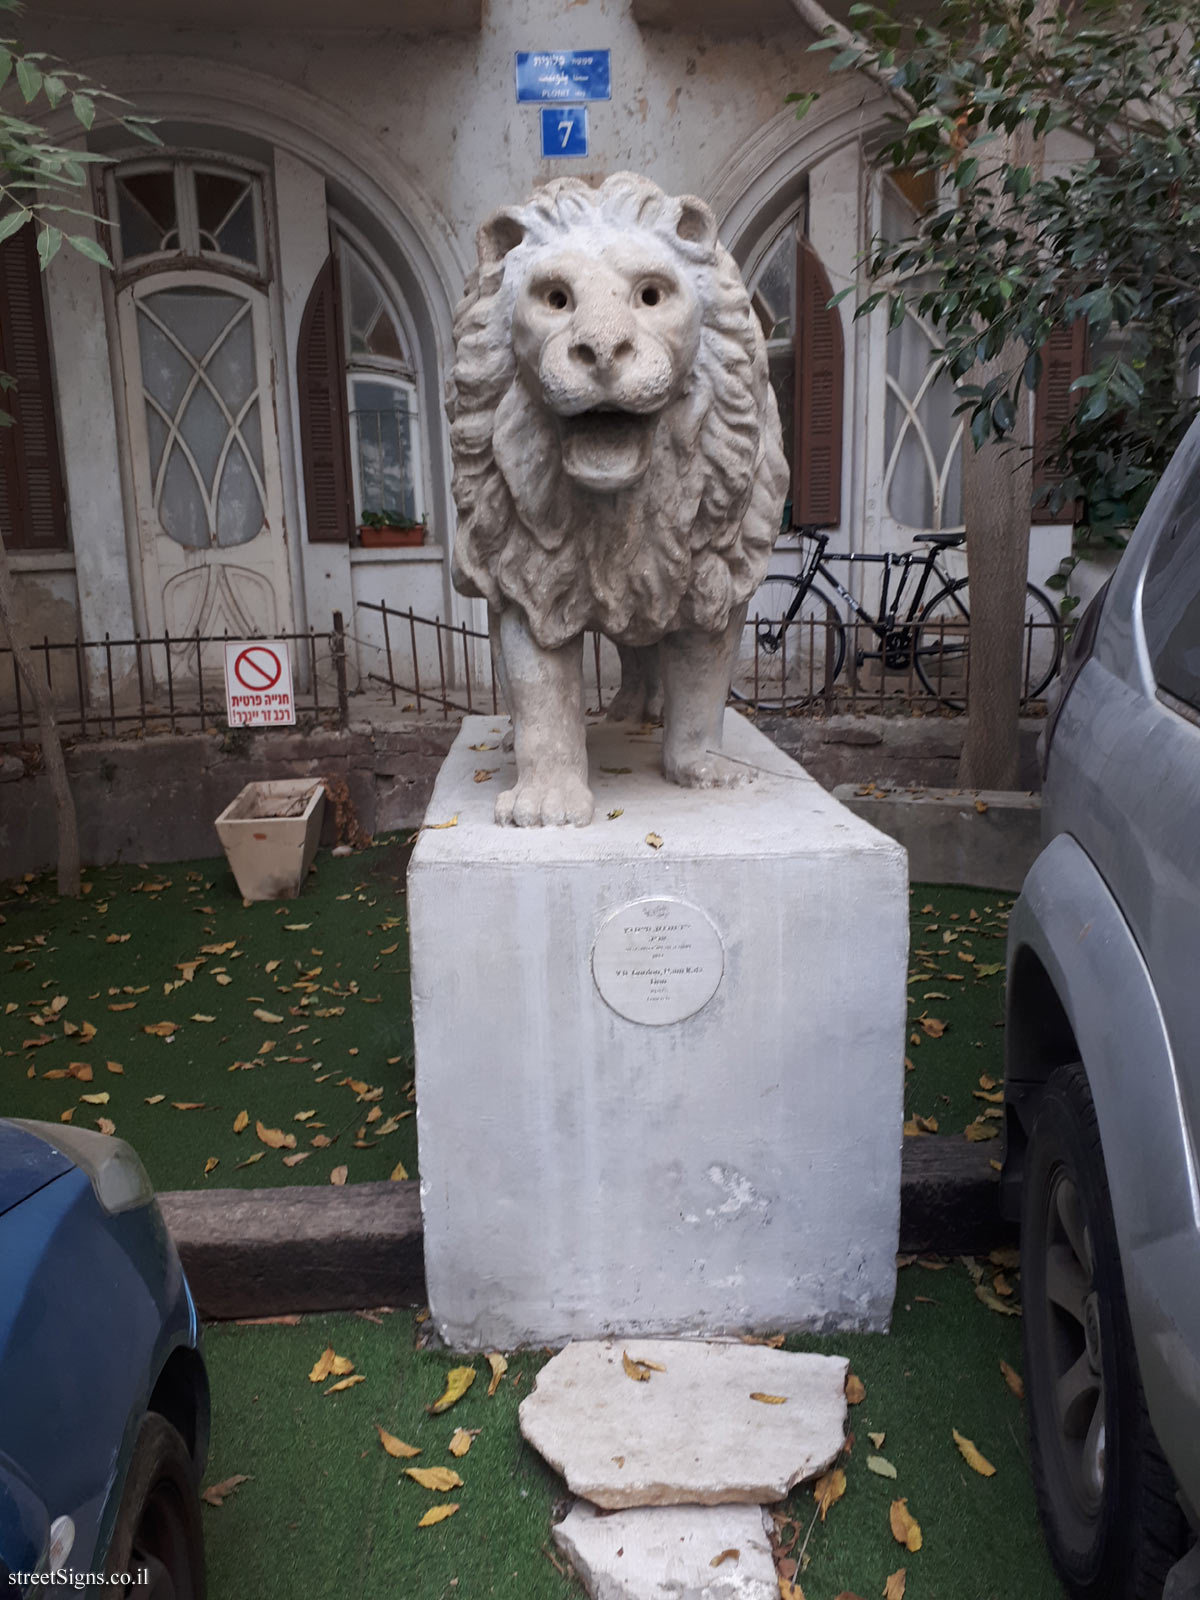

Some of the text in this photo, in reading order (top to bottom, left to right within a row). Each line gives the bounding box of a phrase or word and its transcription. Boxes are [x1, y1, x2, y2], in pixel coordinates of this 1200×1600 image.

[533, 55, 566, 66] פלונית
[557, 120, 574, 148] 7
[231, 694, 289, 707] חנייה פרטית
[261, 709, 272, 722] זר
[274, 709, 290, 720] רכב
